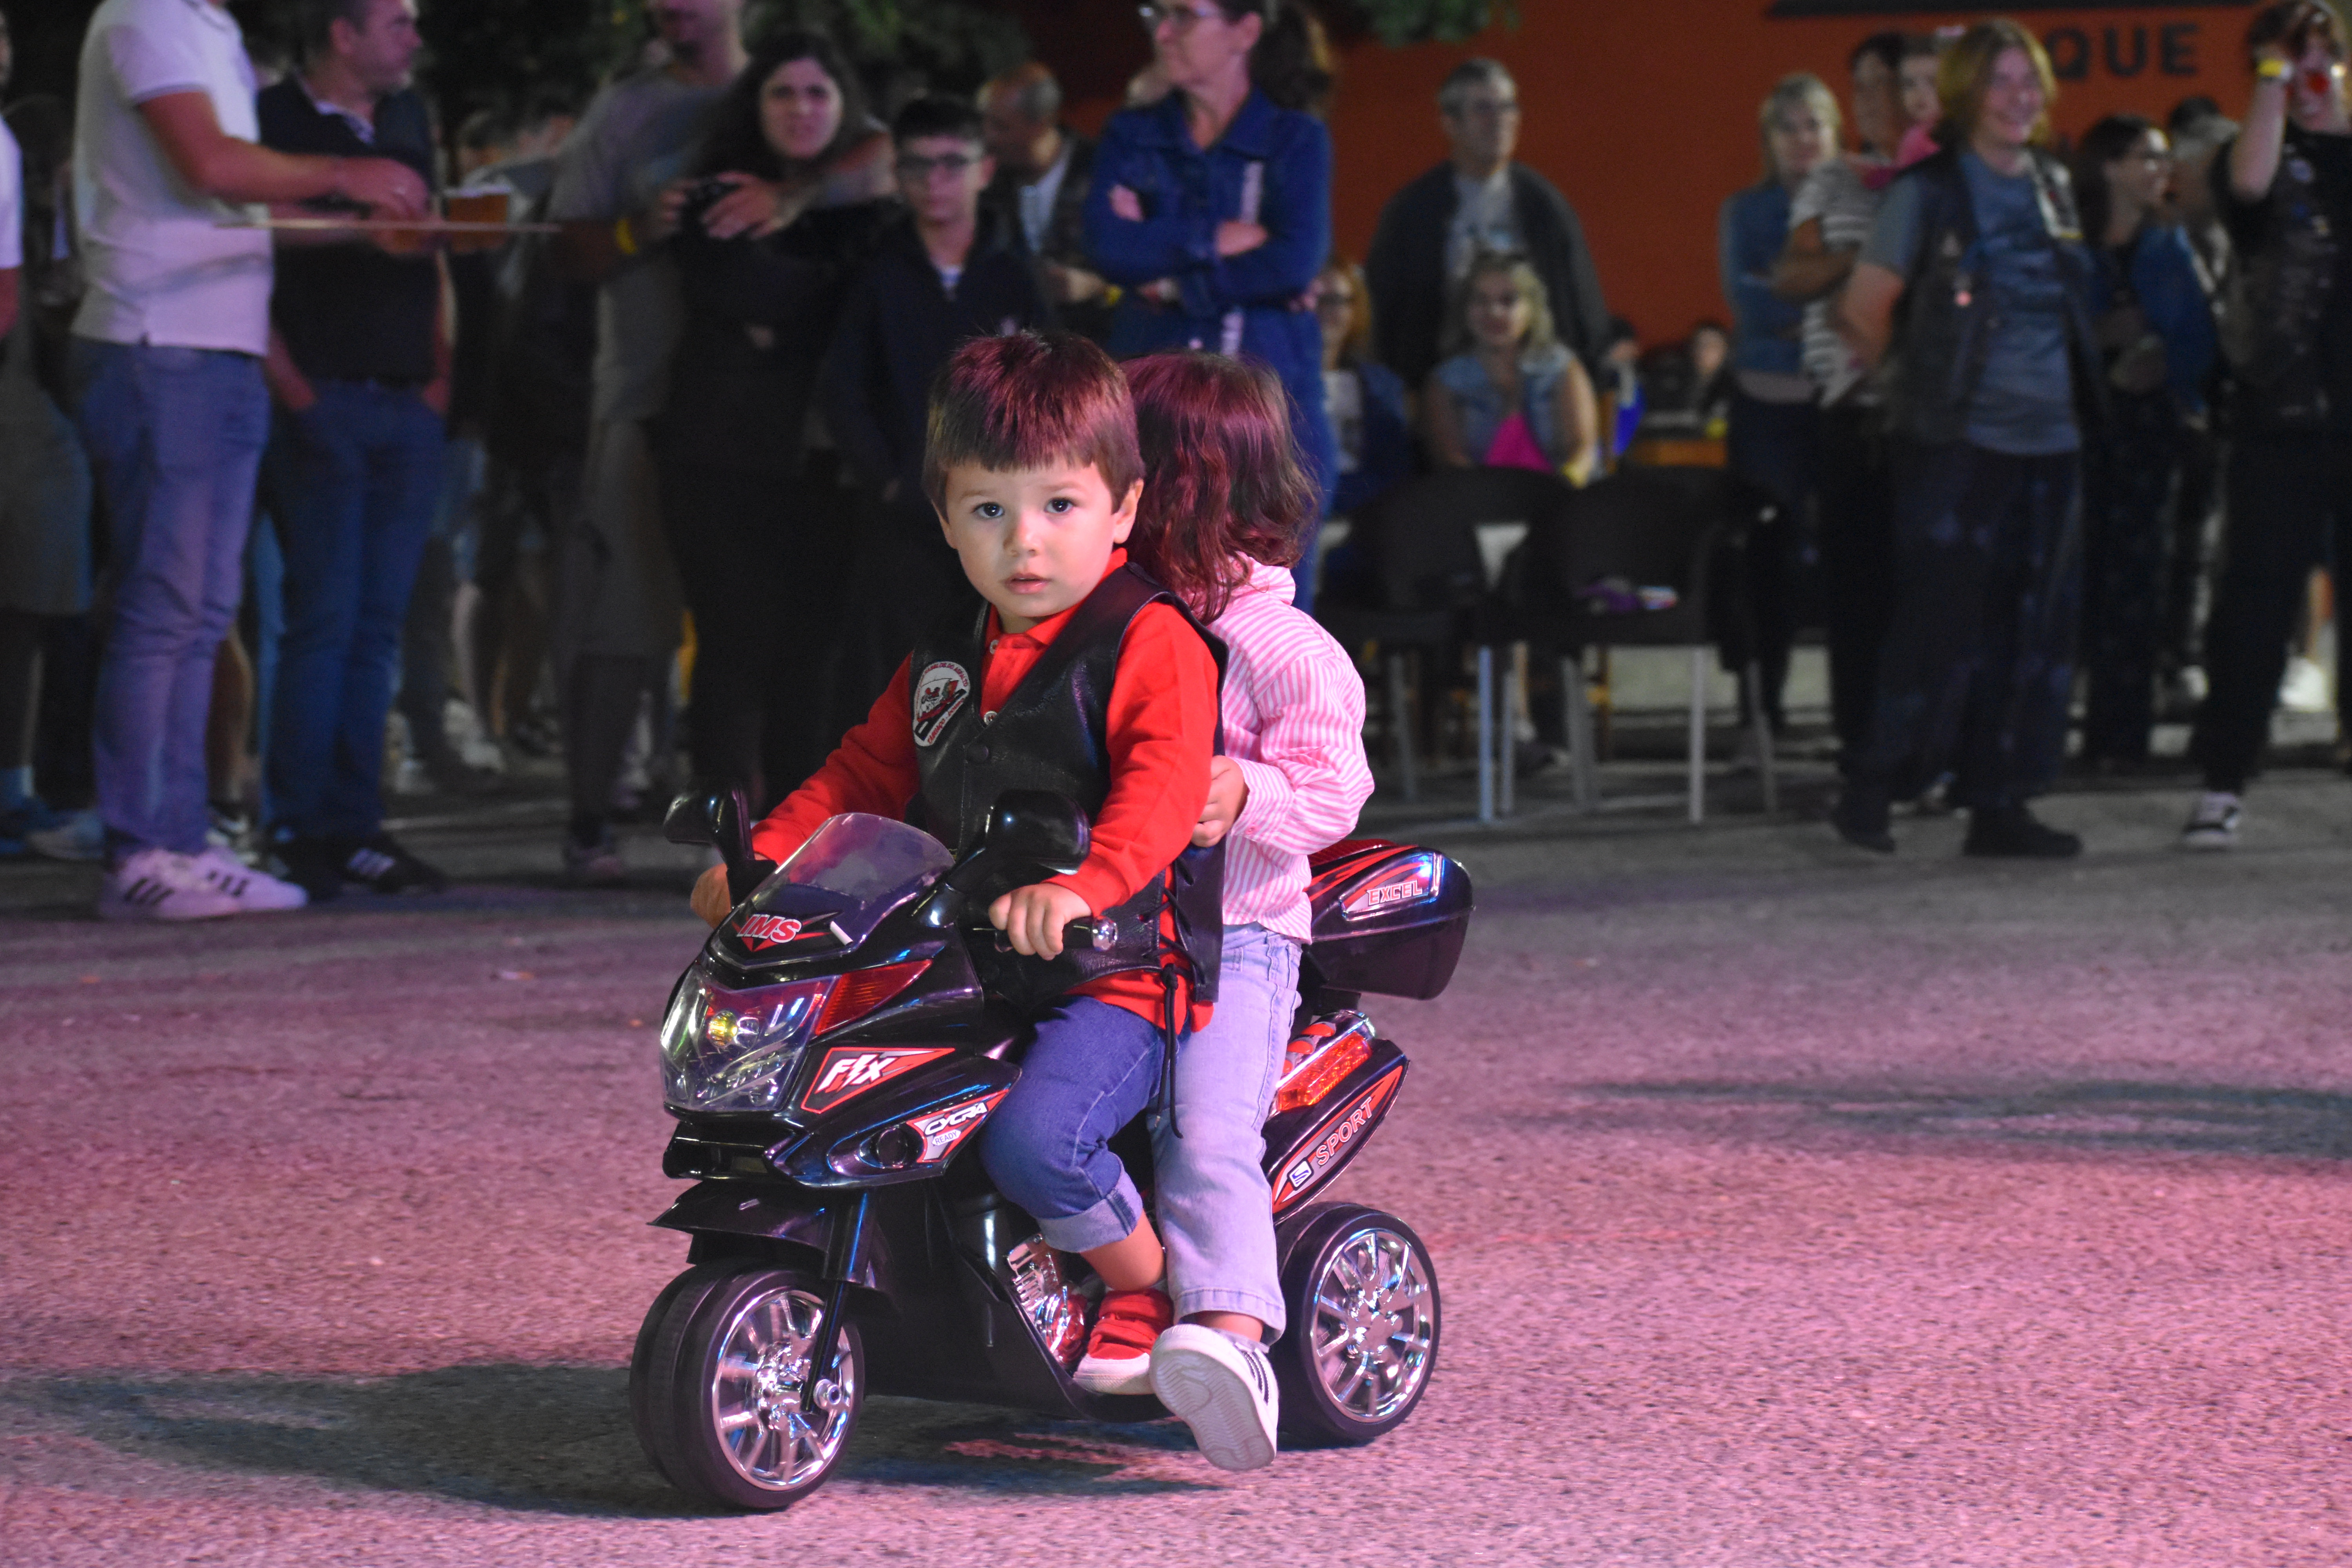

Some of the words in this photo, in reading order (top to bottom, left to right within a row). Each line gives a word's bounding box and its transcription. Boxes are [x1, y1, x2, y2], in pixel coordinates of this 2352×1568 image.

[1367, 880, 1423, 906] EXCEL
[737, 914, 802, 943] IMS
[925, 1102, 987, 1135] CYCRA
[1316, 1096, 1372, 1165] SPORT
[935, 1131, 958, 1145] READY
